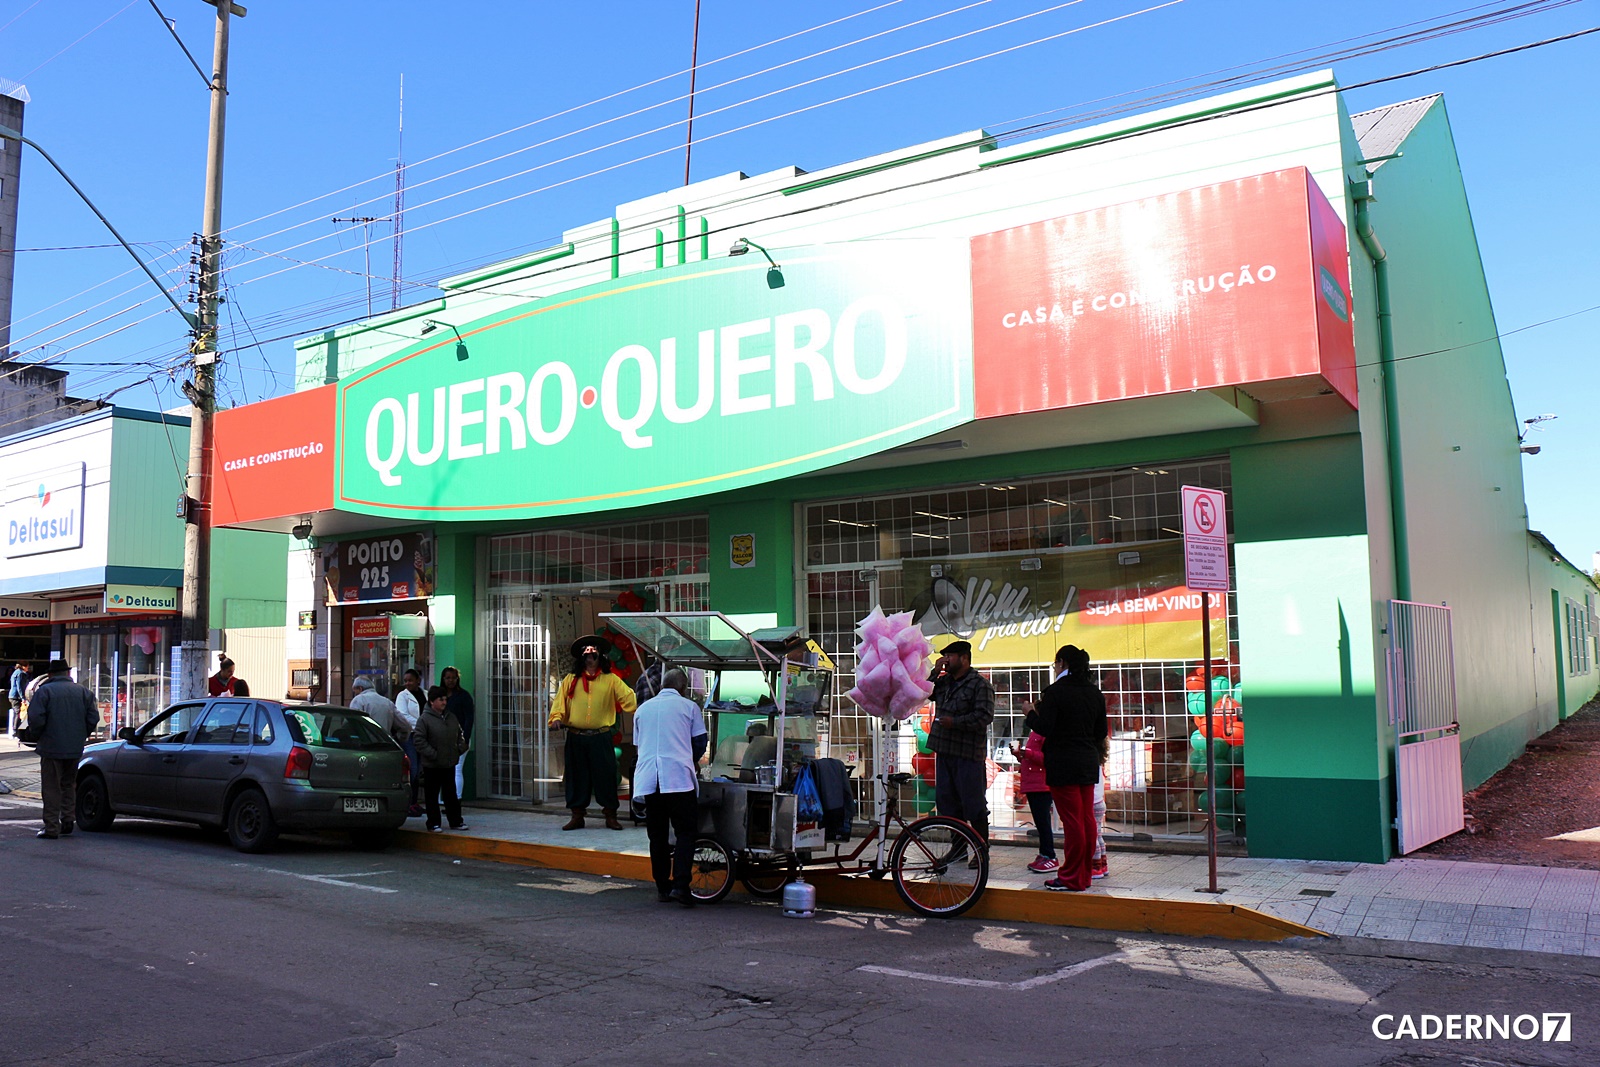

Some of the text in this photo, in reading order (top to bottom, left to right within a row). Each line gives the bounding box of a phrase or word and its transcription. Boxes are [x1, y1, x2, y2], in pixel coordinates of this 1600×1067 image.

[1002, 264, 1277, 328] CASA E CONRUÇÃO
[365, 296, 908, 487] QUERO QUERO
[224, 441, 324, 472] CASA E CONSTRUÇÃO
[8, 508, 74, 546] Deltasul
[347, 538, 404, 566] PONTO
[360, 566, 390, 589] 225
[0, 607, 48, 618] Deltasul
[73, 603, 99, 615] Deltasul
[125, 595, 175, 608] Deltasul
[963, 576, 1032, 626] Vem
[1085, 600, 1122, 617] SEJA
